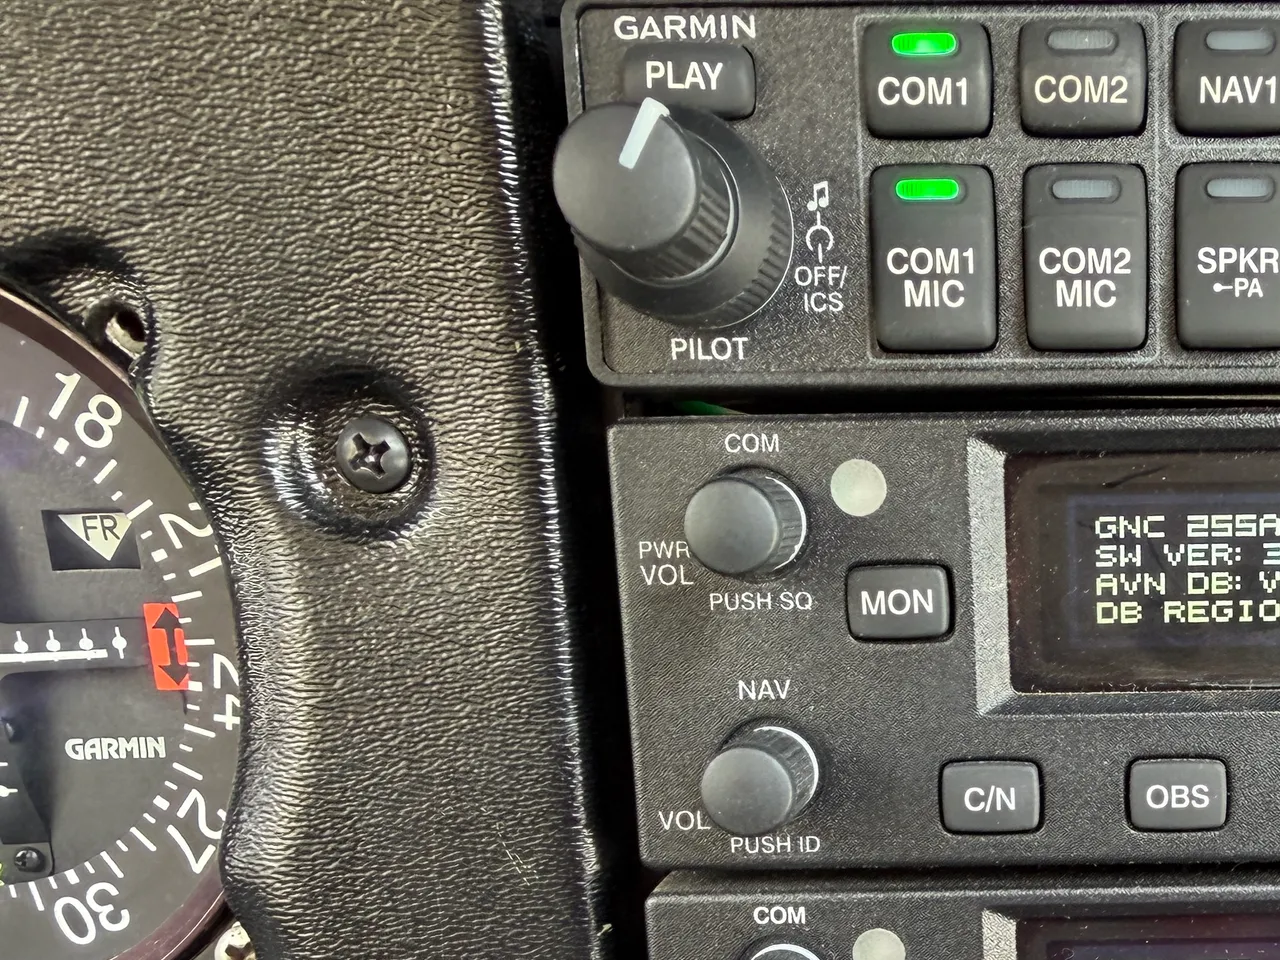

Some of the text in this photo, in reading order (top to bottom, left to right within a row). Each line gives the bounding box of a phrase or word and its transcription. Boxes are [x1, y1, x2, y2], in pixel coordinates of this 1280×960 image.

[614, 15, 756, 40] GARMIN
[645, 61, 723, 90] PLAY
[878, 77, 968, 106] COM1
[1034, 75, 1128, 103] COM2
[1200, 76, 1277, 104] NAV1
[887, 248, 975, 274] COM1
[1039, 247, 1131, 274] COM2
[1197, 247, 1279, 274] SPKR
[794, 266, 848, 288] OFF/
[1234, 277, 1263, 298] PA
[804, 293, 844, 312] ICS
[904, 280, 965, 308] MIC
[1056, 279, 1116, 308] MIC
[671, 338, 748, 360] PILOT
[49, 372, 123, 448] 18
[725, 434, 779, 453] COM
[81, 515, 120, 541] FR
[1095, 513, 1280, 538] GNC 255A
[639, 540, 690, 559] PWR
[1095, 545, 1141, 568] SW
[1164, 543, 1241, 567] VER:
[640, 564, 694, 586] VOL
[1095, 573, 1165, 595] AVN
[1188, 572, 1241, 595] DB:
[710, 592, 813, 611] PUSH SQ
[861, 589, 934, 616] MON
[1096, 601, 1143, 624] DB
[738, 679, 791, 700] NAV
[64, 736, 166, 761] GARMIN
[964, 786, 1016, 812] C/N
[1146, 784, 1210, 809] OBS
[659, 810, 711, 831] VOL
[731, 836, 820, 853] PUSH ID
[53, 882, 130, 945] 30
[753, 906, 805, 925] COM
